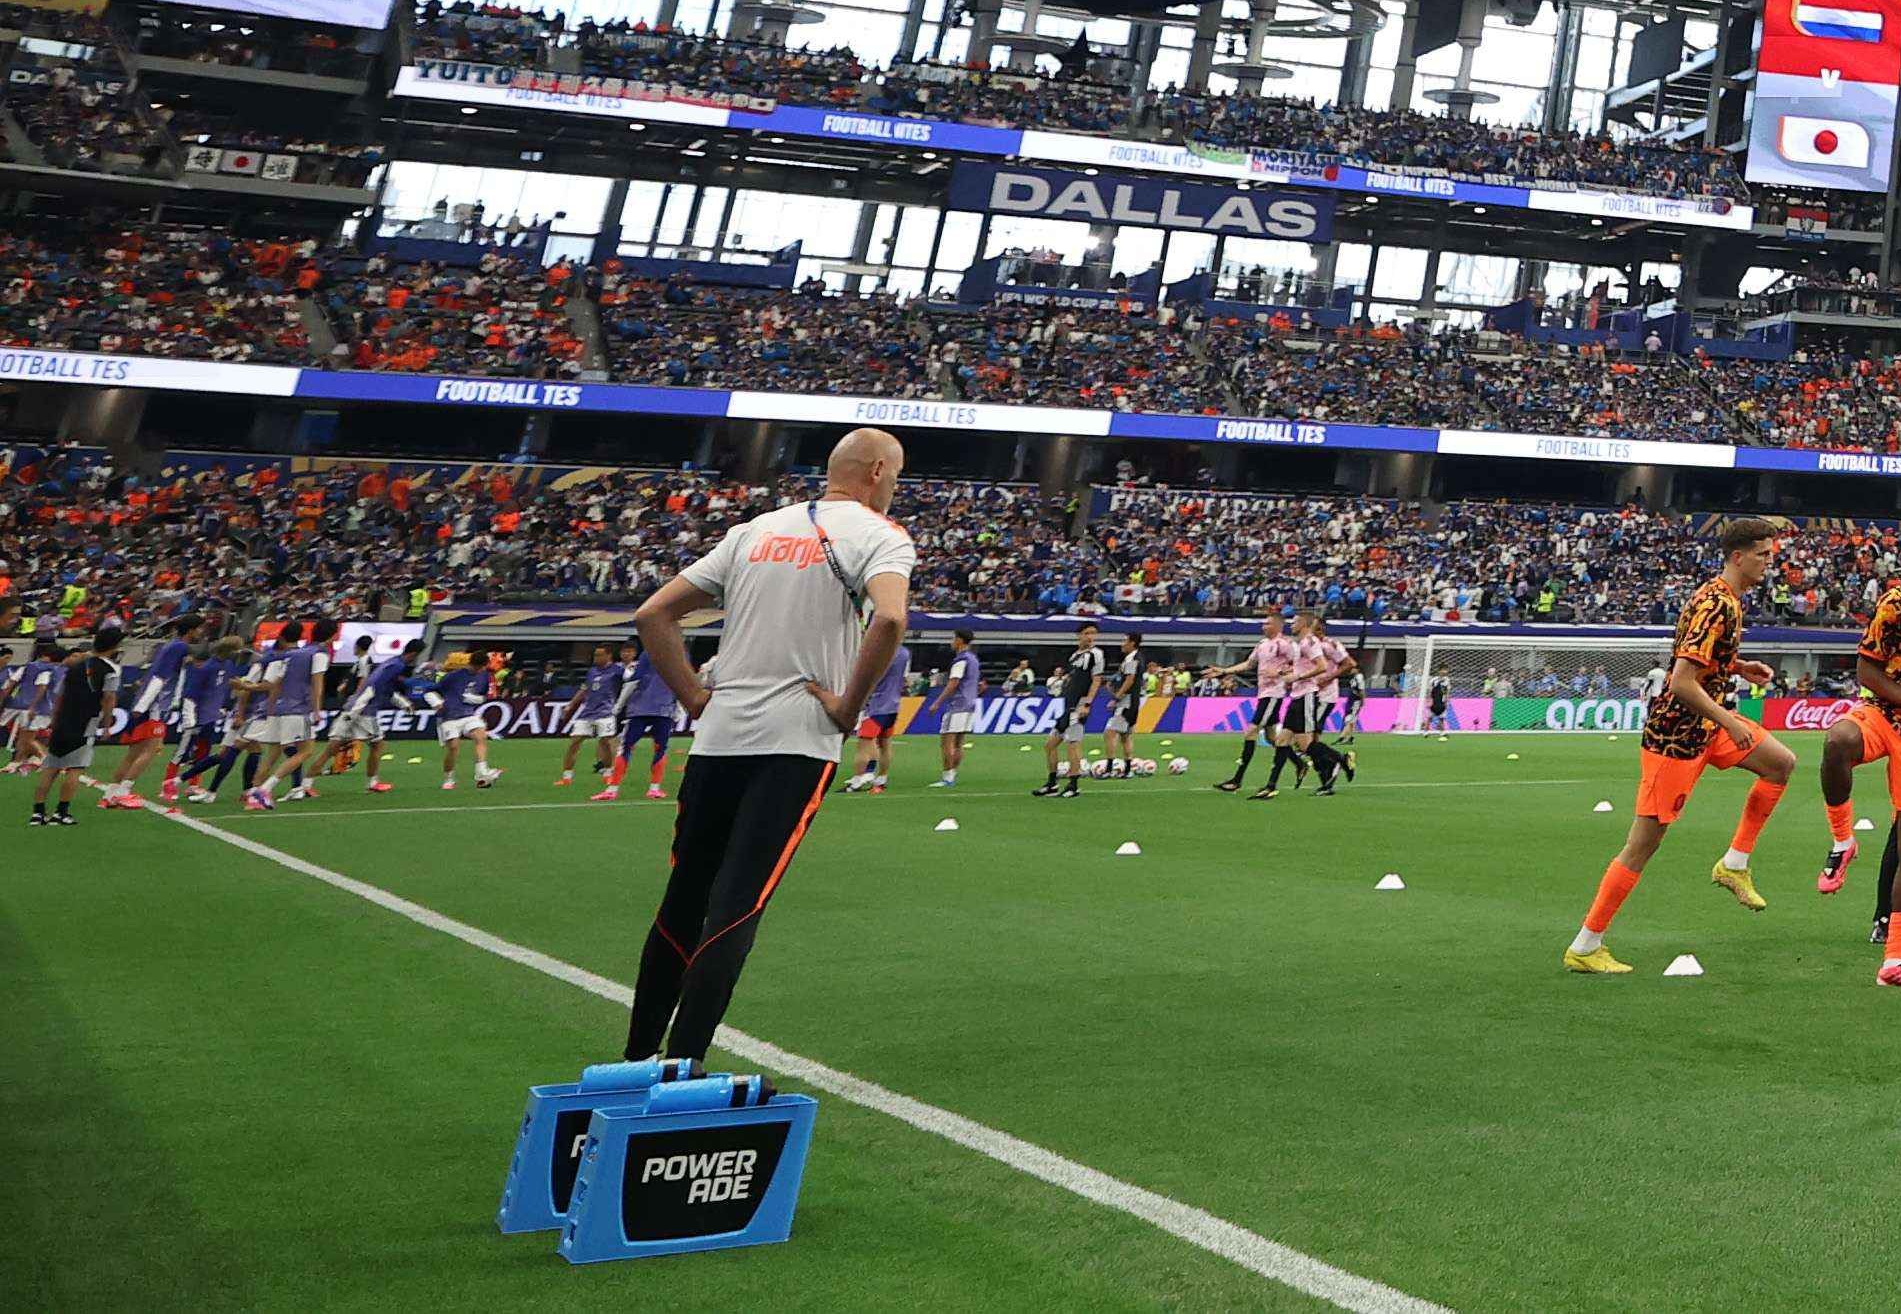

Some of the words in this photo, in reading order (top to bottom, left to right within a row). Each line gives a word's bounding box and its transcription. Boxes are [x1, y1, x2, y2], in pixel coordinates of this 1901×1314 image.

[823, 115, 892, 137] FOOTBALL
[1109, 145, 1167, 165] FOOTBALL
[1367, 172, 1422, 191] FOOTBALL
[988, 171, 1318, 237] DALLAS
[1602, 196, 1652, 214] FOOTBALL
[1024, 294, 1071, 307] WOLD
[90, 359, 129, 380] TES
[437, 380, 537, 403] FOOTBALL
[544, 385, 581, 405] TES
[855, 403, 940, 425] FOOTBALL
[948, 403, 976, 424] TES
[1217, 421, 1293, 441] FOOTBALL
[1297, 425, 1325, 443] TES
[1536, 439, 1602, 458] FOOTBALL
[1607, 441, 1630, 458] TES
[1819, 454, 1879, 471] FOOTBALL
[972, 698, 1066, 734] VISA
[641, 1149, 757, 1184] POWER
[687, 1174, 752, 1205] ADE
